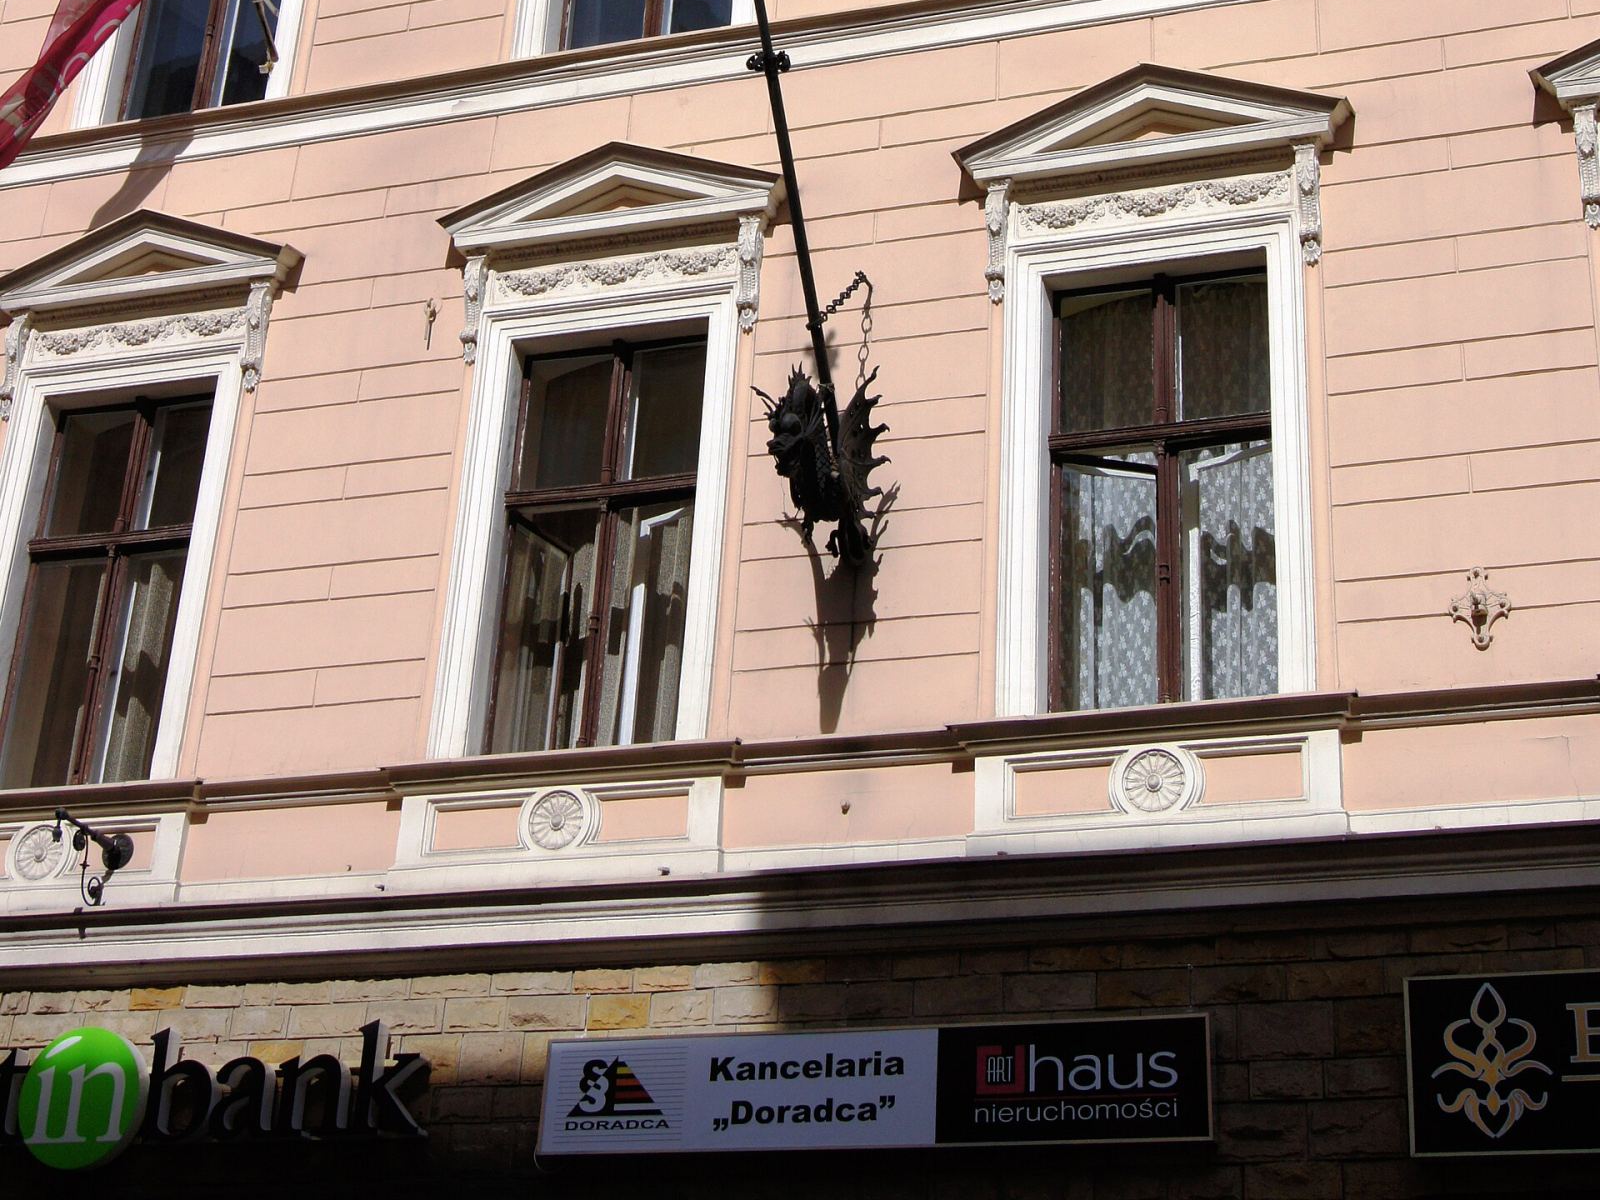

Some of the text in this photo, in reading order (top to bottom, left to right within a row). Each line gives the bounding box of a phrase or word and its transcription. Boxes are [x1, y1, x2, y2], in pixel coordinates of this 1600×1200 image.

[709, 1051, 905, 1082] Kancelaria
[1029, 1043, 1179, 1093] haus
[565, 1119, 670, 1131] DORADCA
[974, 1097, 1178, 1124] nieruchomości
